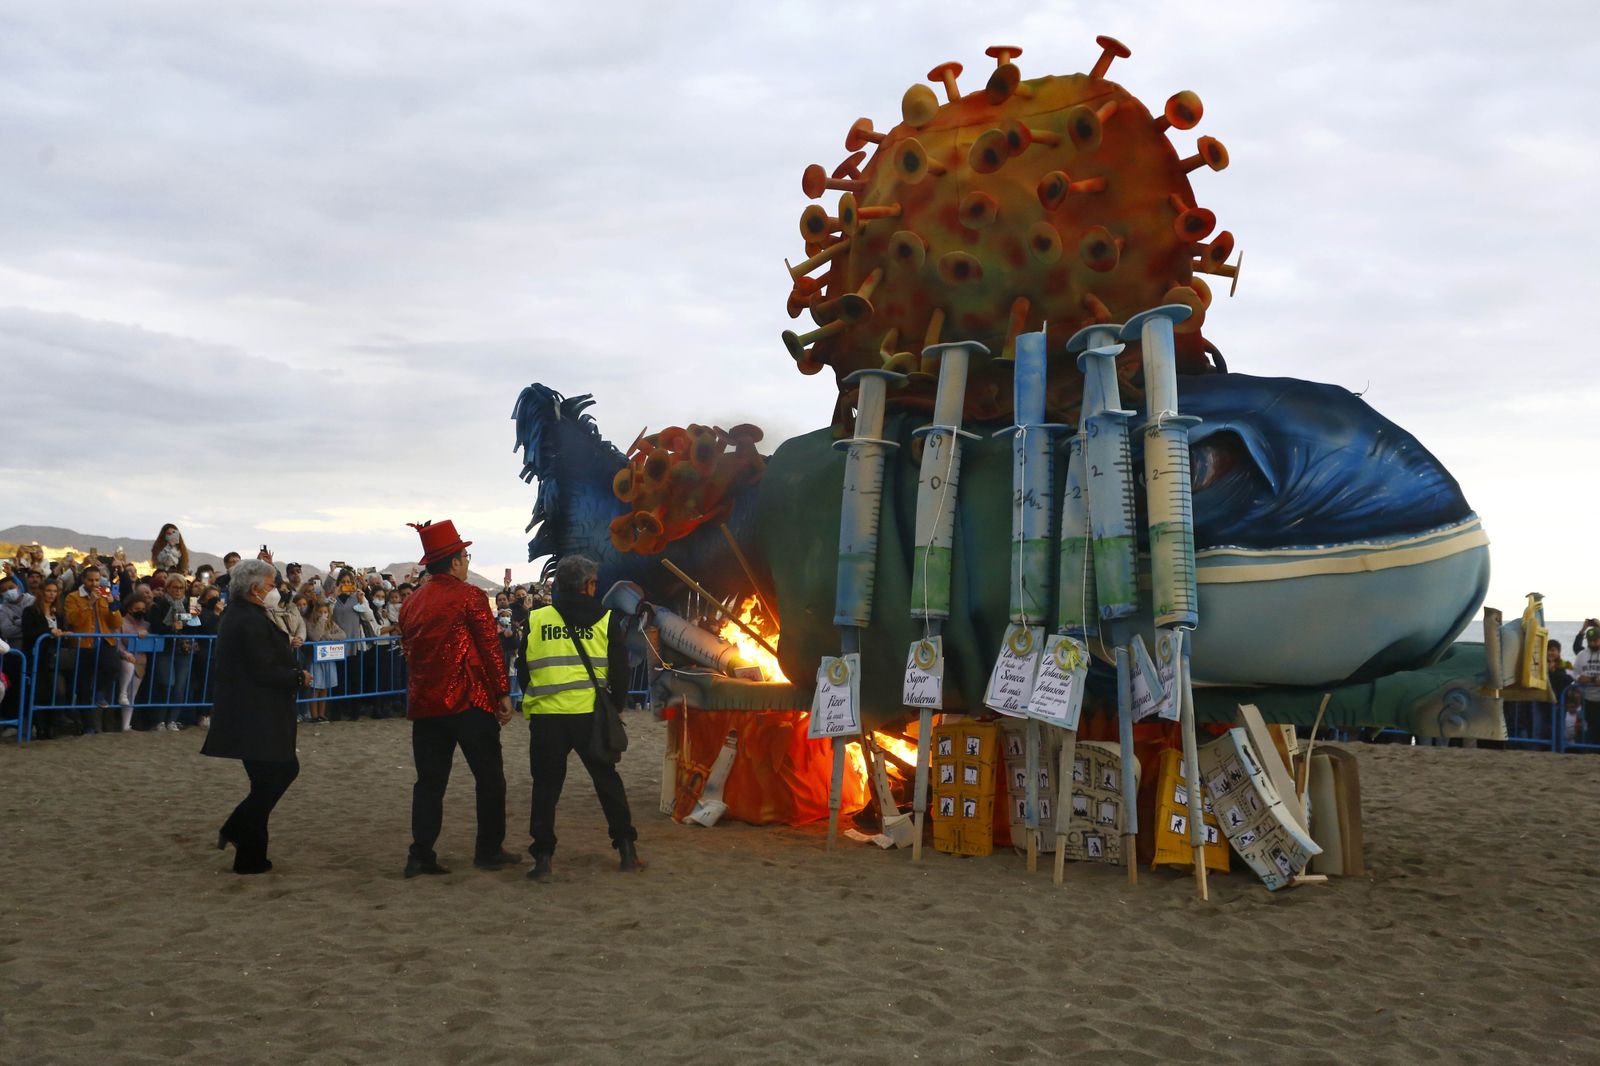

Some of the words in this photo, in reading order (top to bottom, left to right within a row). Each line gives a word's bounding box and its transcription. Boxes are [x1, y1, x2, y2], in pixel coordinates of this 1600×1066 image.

[1091, 465, 1104, 477] 2
[1152, 469, 1159, 480] 2
[1072, 486, 1082, 499] 2
[541, 624, 594, 641] Fiesas
[1042, 655, 1053, 666] La
[1001, 669, 1025, 683] Seneca
[1040, 666, 1070, 681] Johnson
[906, 672, 929, 690] Super
[1035, 681, 1065, 695] Johnson
[903, 691, 936, 705] Moderna
